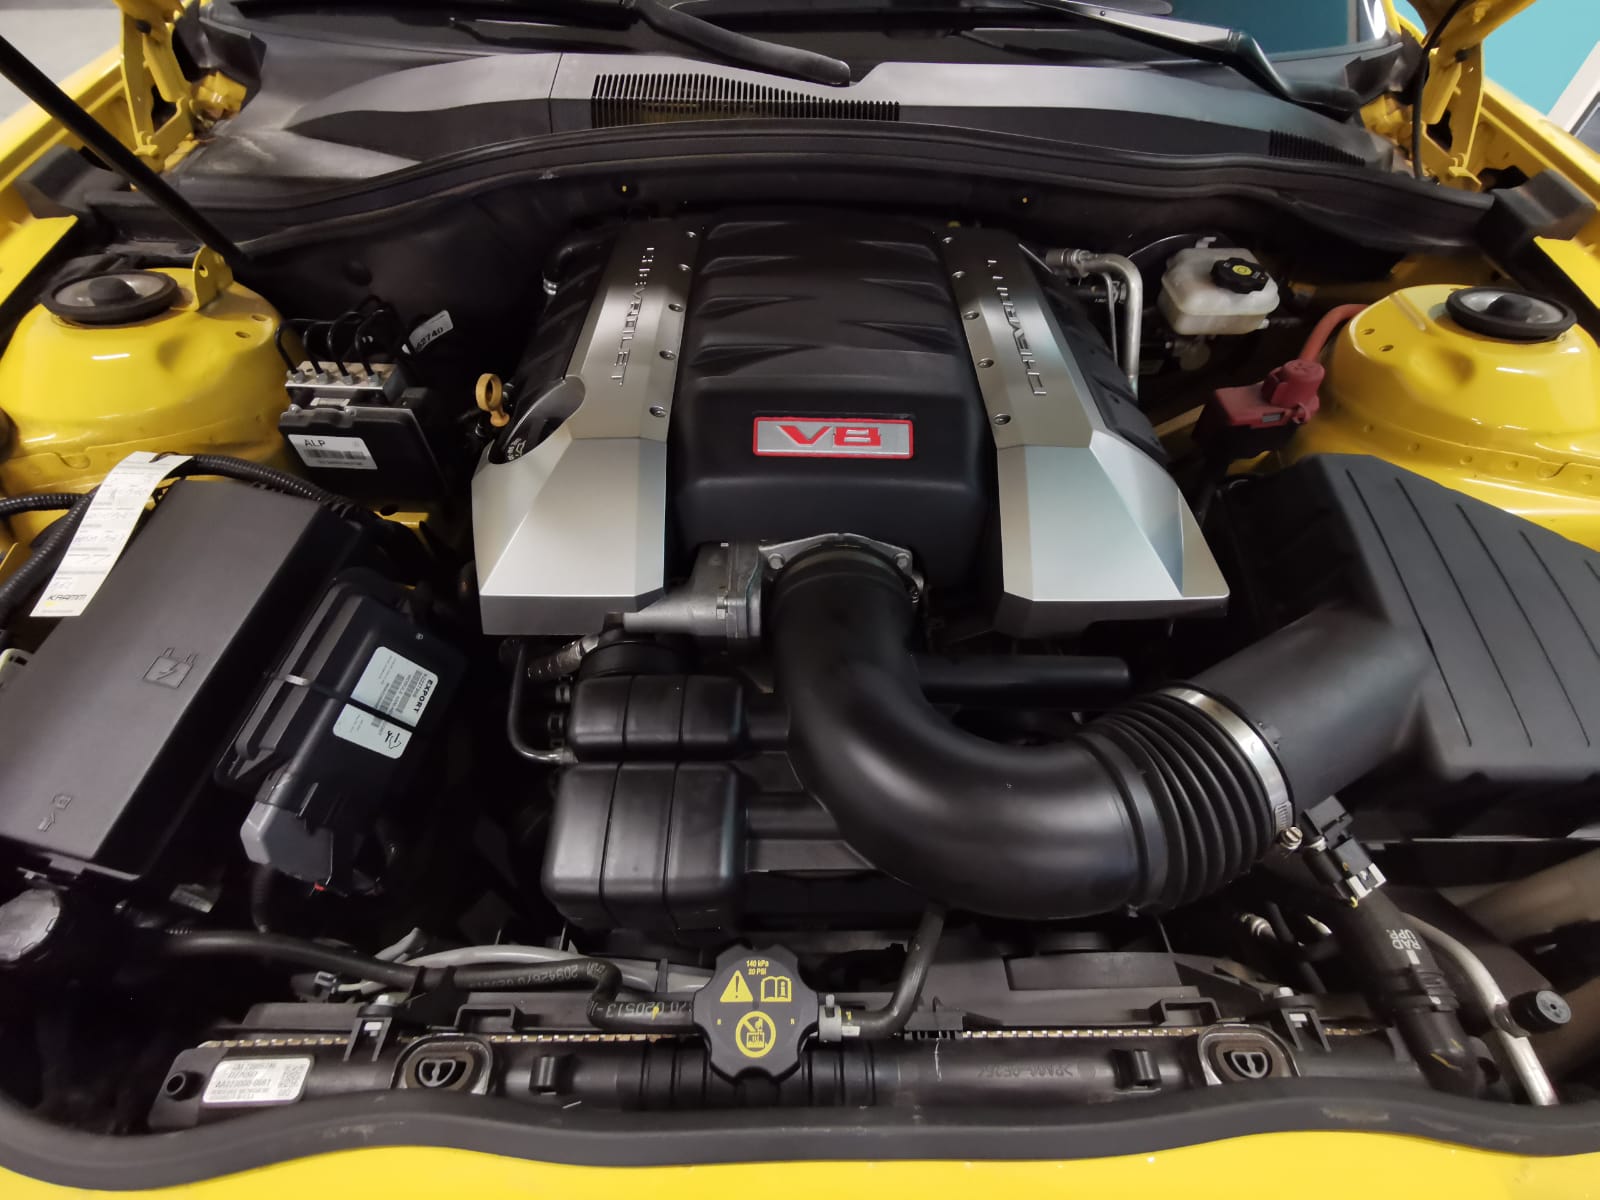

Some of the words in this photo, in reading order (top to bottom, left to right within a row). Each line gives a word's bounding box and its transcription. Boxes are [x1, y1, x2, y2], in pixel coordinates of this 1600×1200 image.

[776, 425, 882, 448] V8
[413, 679, 434, 714] EXPORT
[1392, 938, 1422, 950] RAD
